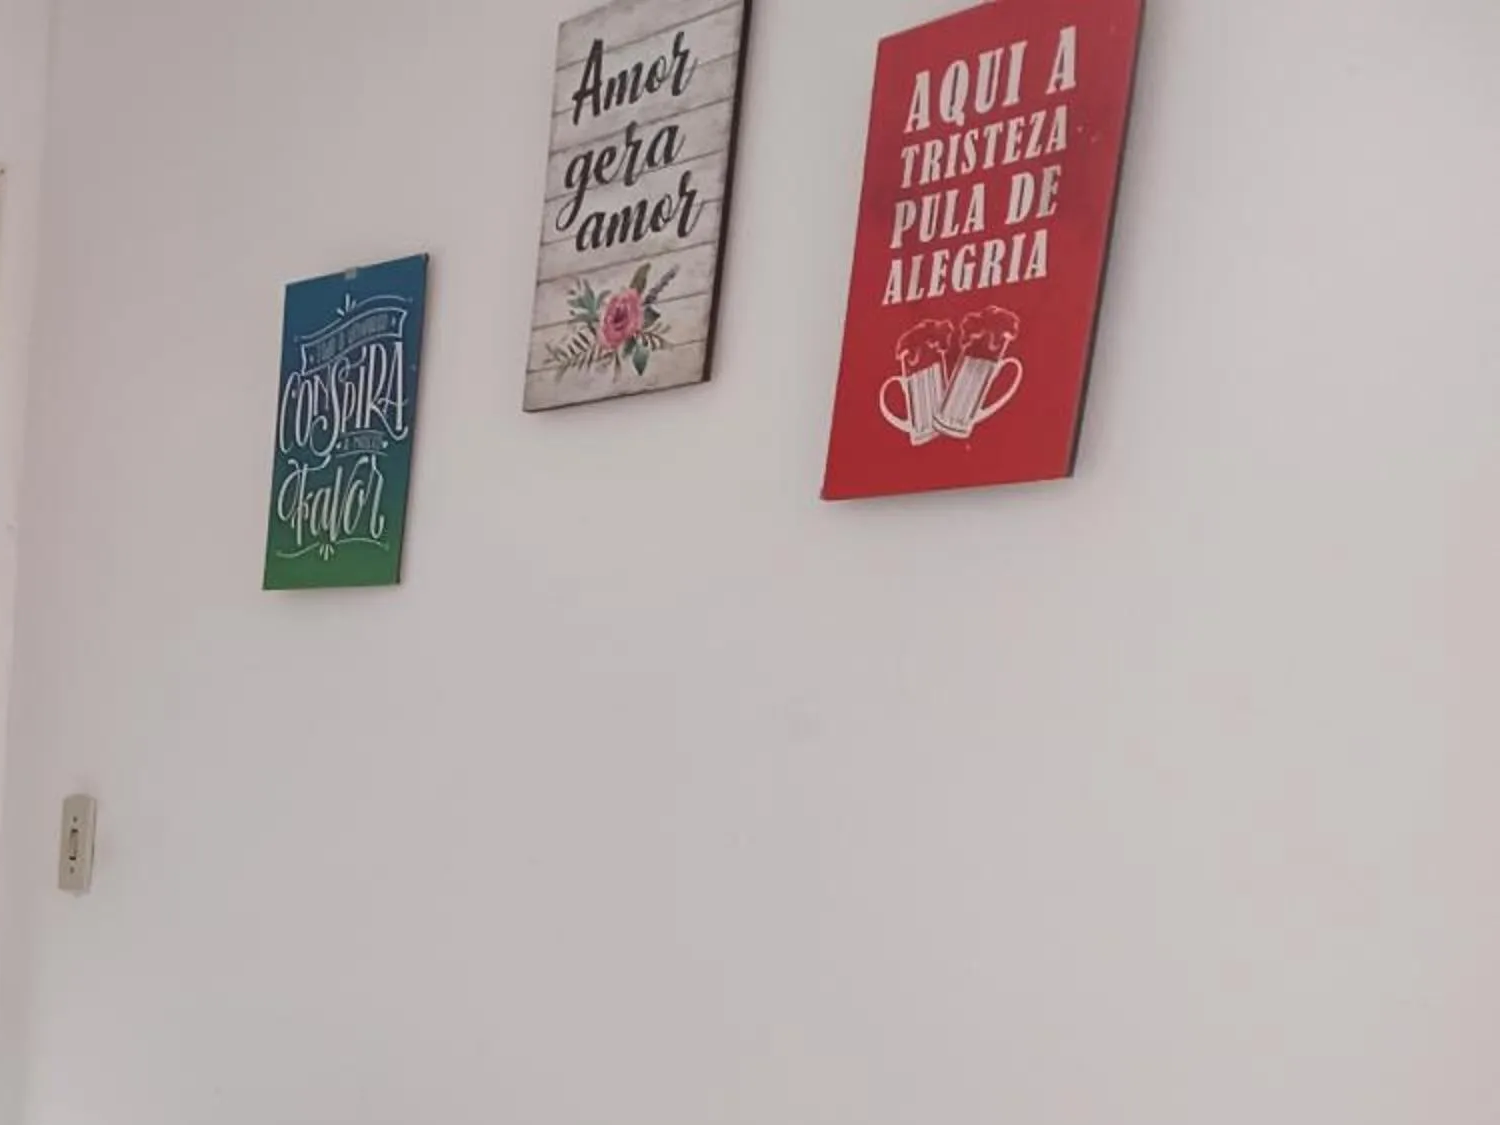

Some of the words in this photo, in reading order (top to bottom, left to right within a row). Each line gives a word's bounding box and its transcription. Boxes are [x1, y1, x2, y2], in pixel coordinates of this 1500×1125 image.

[572, 31, 699, 126] Amor
[904, 40, 1028, 134] AQUI
[1045, 26, 1077, 95] A
[556, 120, 686, 231] gera
[901, 105, 1068, 189] TRISTEZA
[575, 169, 703, 253] amor
[890, 182, 987, 249] PULA
[1006, 166, 1062, 225] DE
[882, 229, 1049, 306] ALEGRIA
